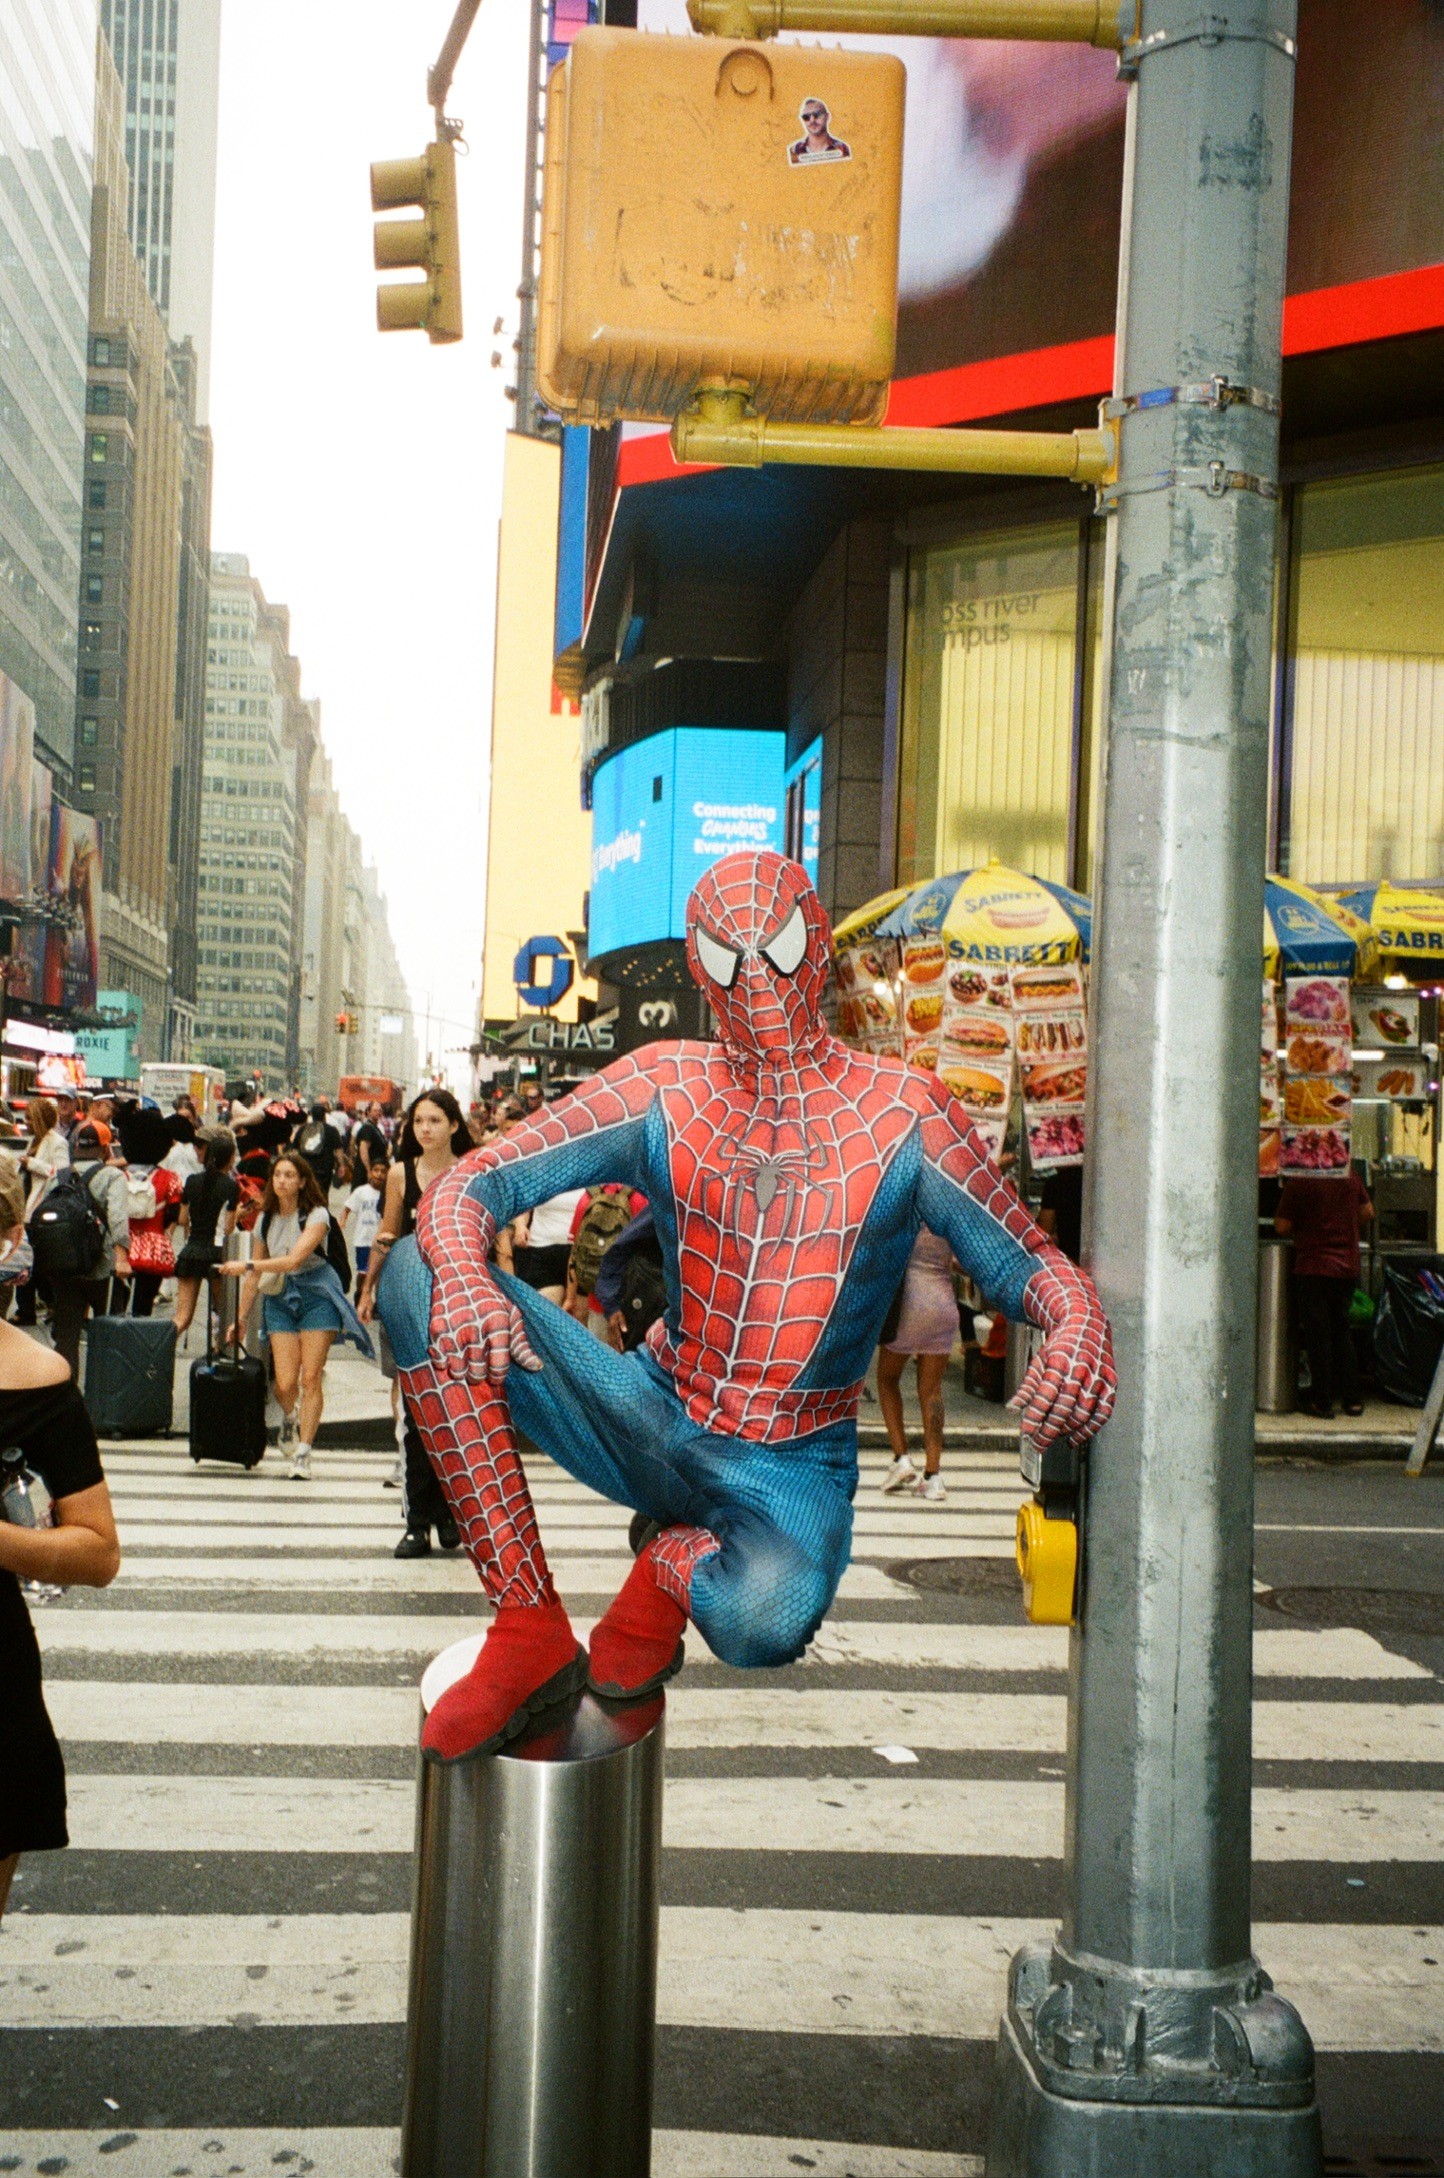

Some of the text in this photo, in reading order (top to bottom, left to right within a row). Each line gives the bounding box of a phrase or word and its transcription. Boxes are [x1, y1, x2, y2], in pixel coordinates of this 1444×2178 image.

[939, 594, 1039, 624] oss river
[943, 623, 1010, 654] mpus
[693, 802, 776, 822] Connecting
[965, 892, 1042, 914] SABRETT
[1379, 930, 1443, 949] SABR
[949, 939, 1071, 964] SABRETT
[76, 1036, 109, 1050] ROXIE
